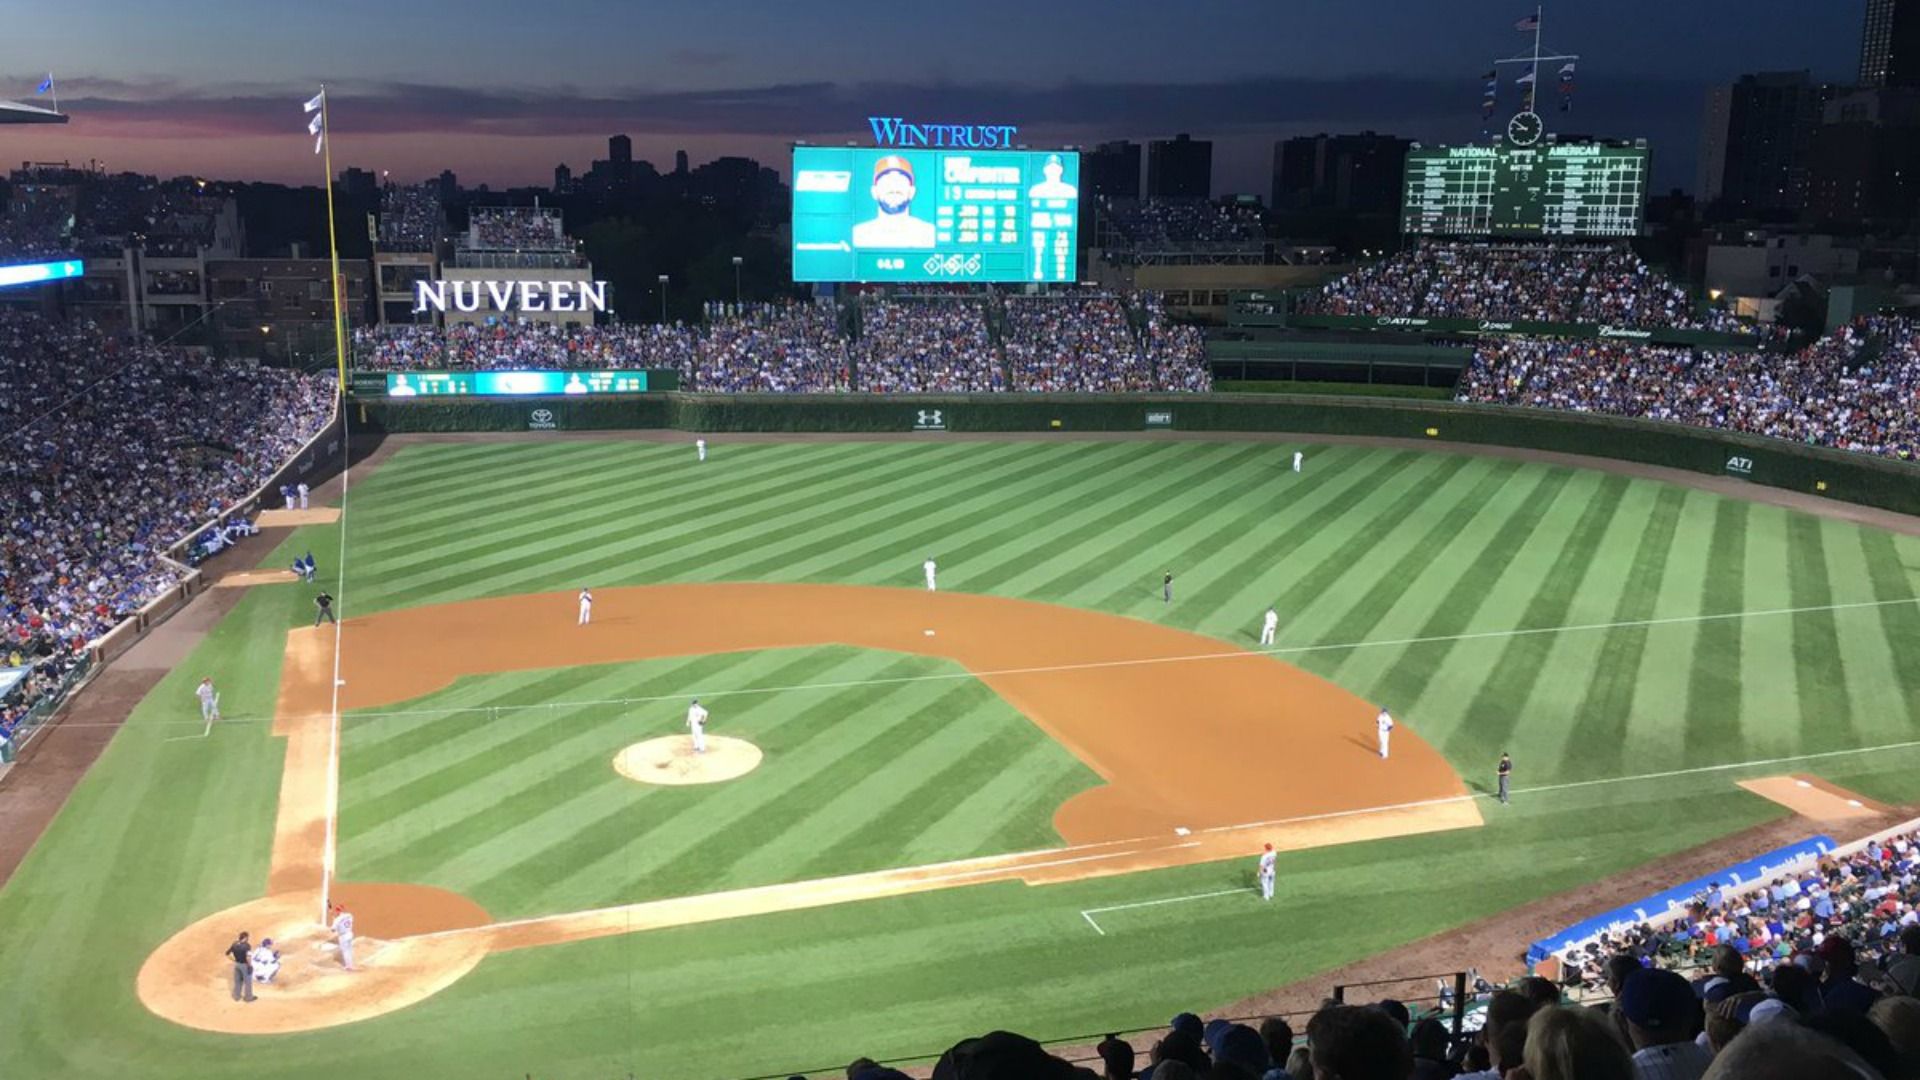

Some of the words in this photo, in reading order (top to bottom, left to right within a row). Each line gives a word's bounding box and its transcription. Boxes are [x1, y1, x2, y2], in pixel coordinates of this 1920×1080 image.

[868, 117, 1016, 147] WINTRUST
[1449, 147, 1498, 158] NATIONAL
[1548, 146, 1600, 156] AMERICAN
[416, 280, 607, 312] NUVEEN
[1390, 317, 1411, 325] ATI
[1598, 324, 1652, 338] Budweiser
[528, 421, 556, 429] TOYOTA
[1727, 456, 1753, 469] ATI
